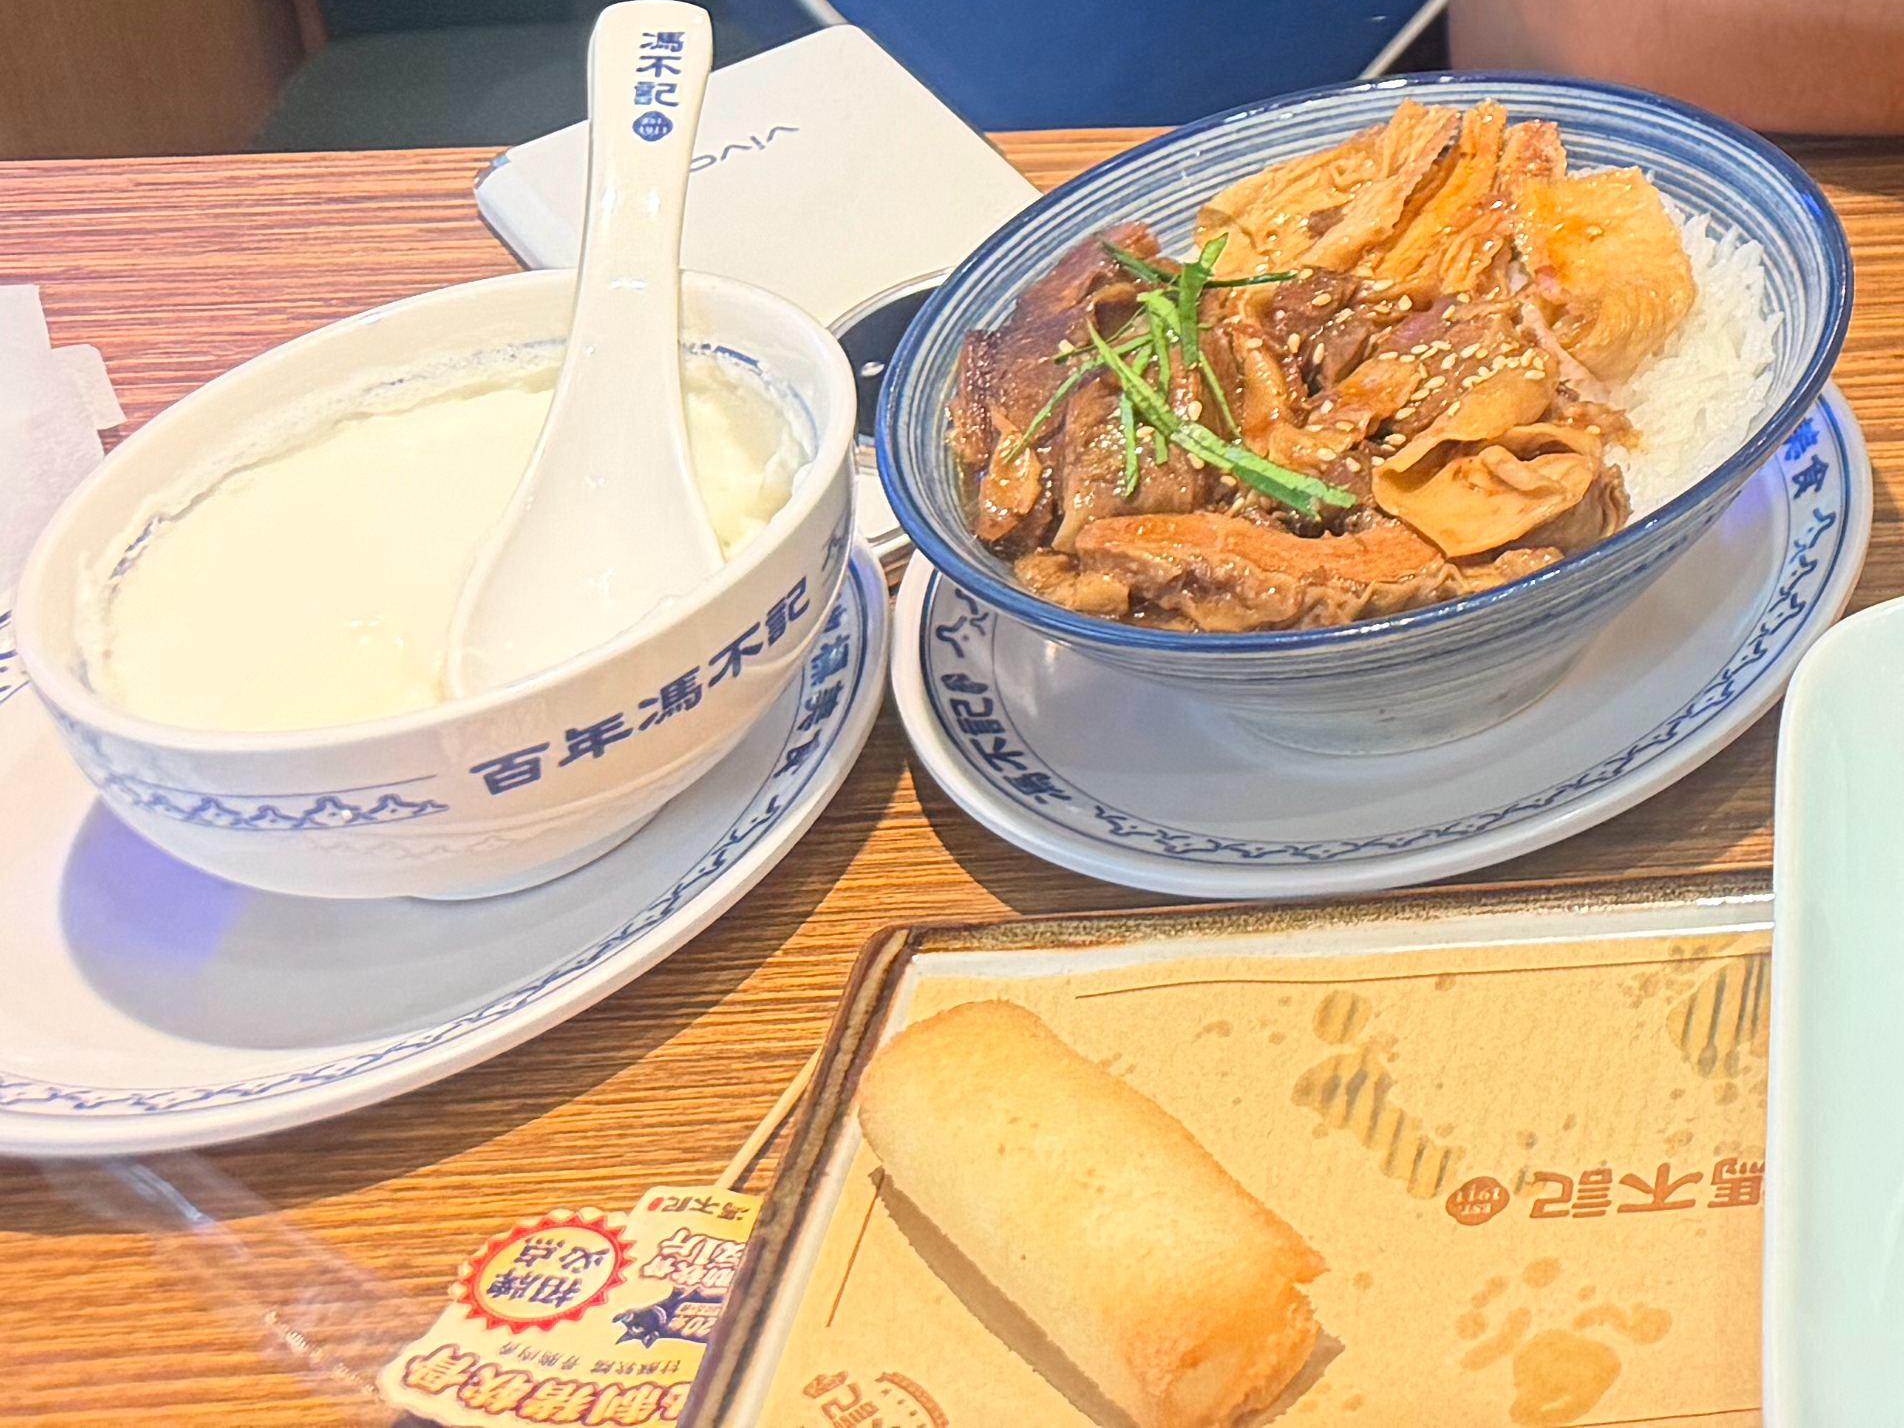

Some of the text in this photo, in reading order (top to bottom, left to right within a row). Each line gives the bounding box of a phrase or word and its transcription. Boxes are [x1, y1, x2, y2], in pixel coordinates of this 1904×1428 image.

[633, 32, 685, 107] 馮不記
[470, 576, 810, 796] 百年馮不記
